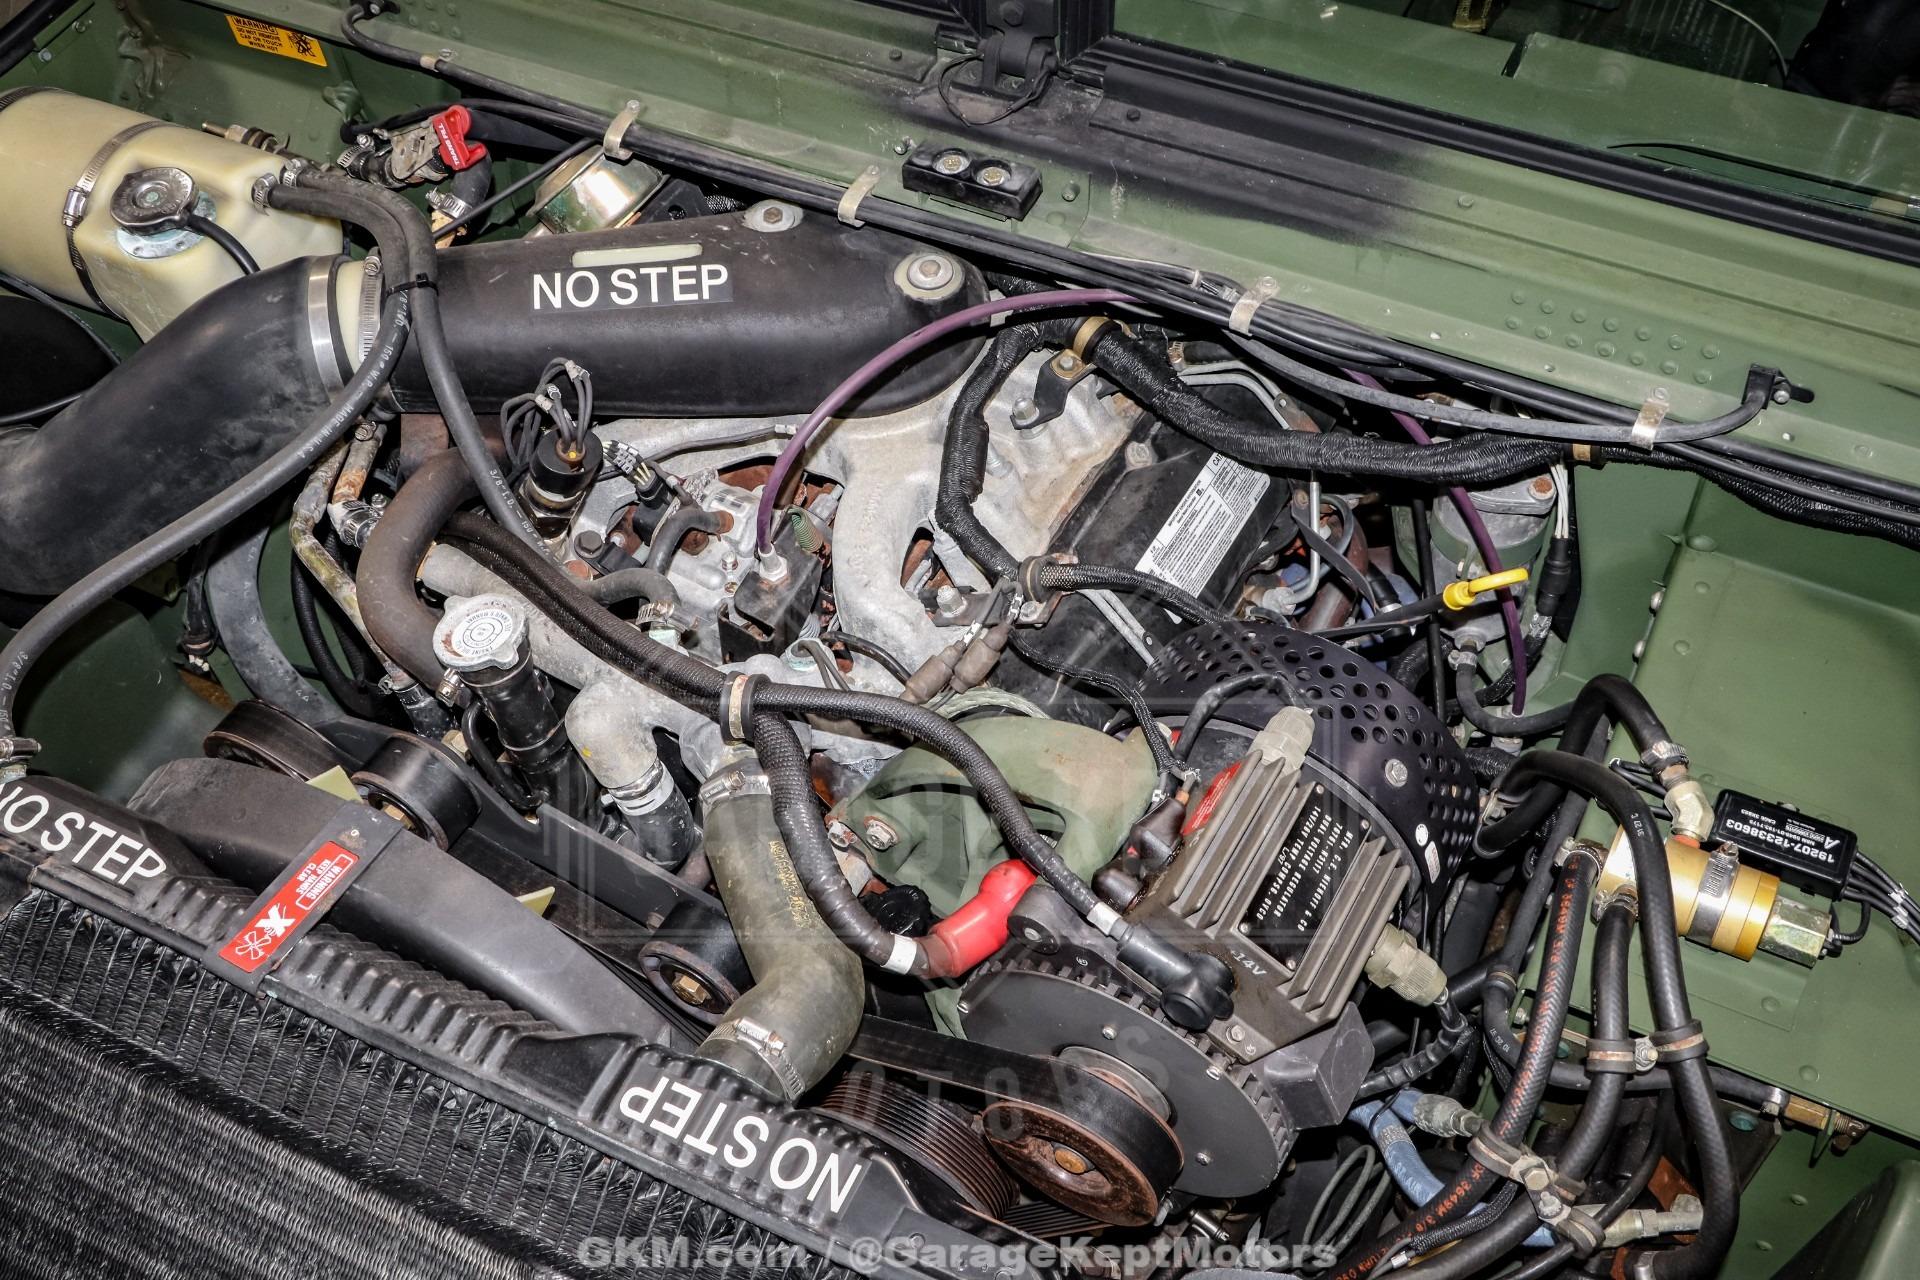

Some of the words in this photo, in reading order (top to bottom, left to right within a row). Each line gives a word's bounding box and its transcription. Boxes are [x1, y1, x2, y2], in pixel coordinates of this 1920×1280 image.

[235, 18, 276, 33] WARNING
[438, 122, 449, 140] FILL
[445, 140, 460, 166] TRANS
[533, 271, 600, 310] NO
[610, 264, 729, 305] STEP
[1301, 806, 1322, 838] 14V/28V
[1317, 814, 1332, 835] DUAL
[40, 812, 167, 886] STEP
[1290, 838, 1304, 860] TEMP
[1298, 836, 1320, 871] VOLTAGE
[1726, 818, 1835, 864] 19207-12338603
[297, 863, 317, 882] CLEAR
[307, 864, 343, 900] WARNING
[316, 859, 332, 875] KEEP
[296, 874, 318, 895] HANDS
[1274, 872, 1302, 918] REGULATOR
[1310, 874, 1332, 910] NIEHOFF
[619, 1076, 770, 1168] STEP
[769, 1137, 862, 1213] NO
[1436, 1180, 1472, 1216] 3649M
[1415, 1215, 1436, 1232] 3/8
